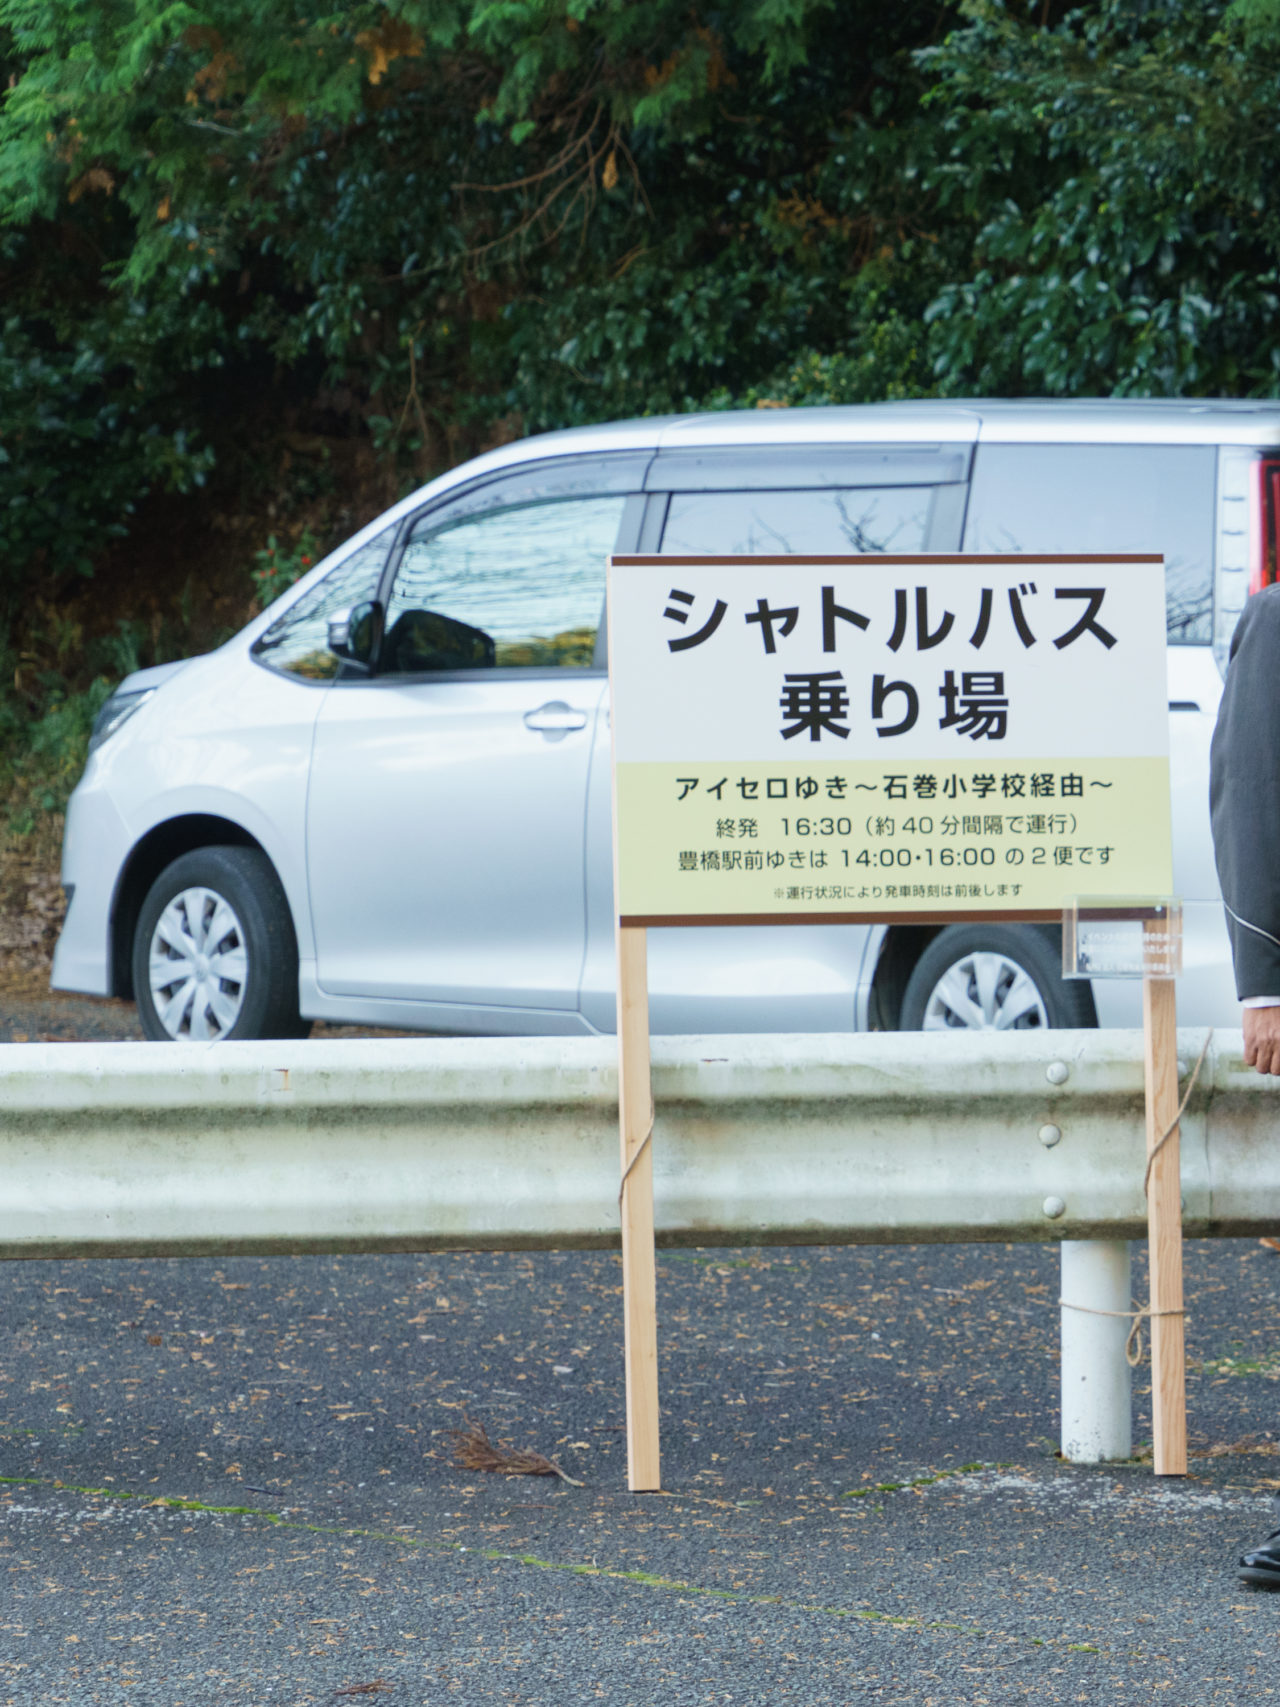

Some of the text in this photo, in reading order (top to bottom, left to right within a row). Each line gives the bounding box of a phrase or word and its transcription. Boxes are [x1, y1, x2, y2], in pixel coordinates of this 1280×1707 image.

[662, 582, 1118, 655] シャトルバス
[779, 670, 1009, 743] 乗り場
[715, 818, 759, 839] 終発
